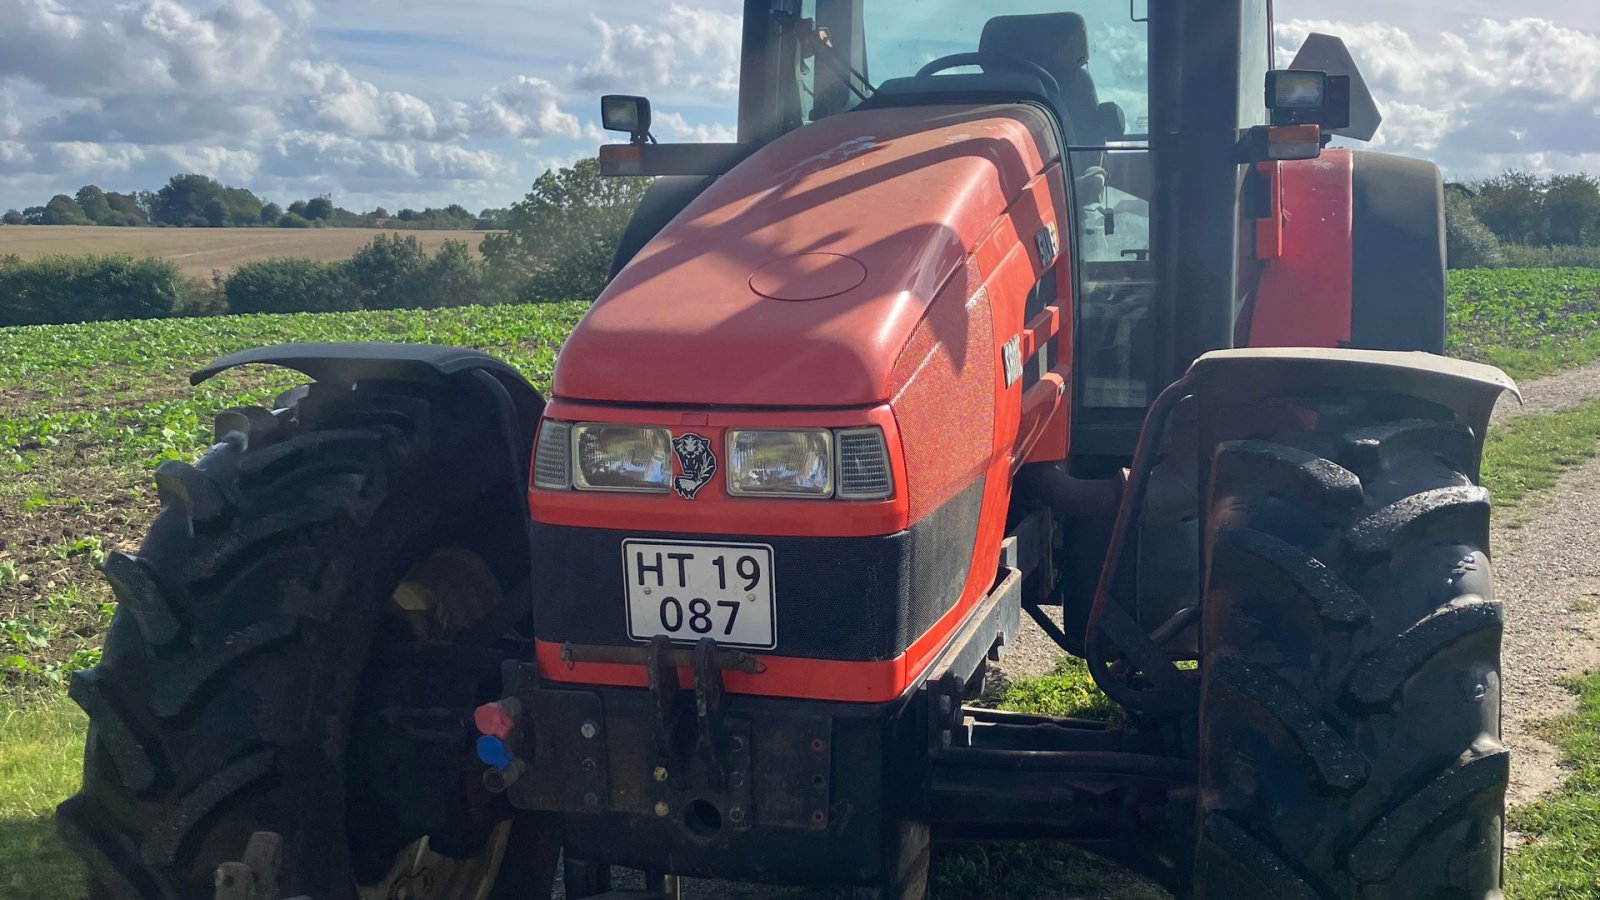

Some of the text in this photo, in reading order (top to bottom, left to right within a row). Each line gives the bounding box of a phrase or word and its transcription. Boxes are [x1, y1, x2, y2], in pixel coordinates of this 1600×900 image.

[636, 551, 761, 592] HT 19
[659, 596, 741, 635] 087
